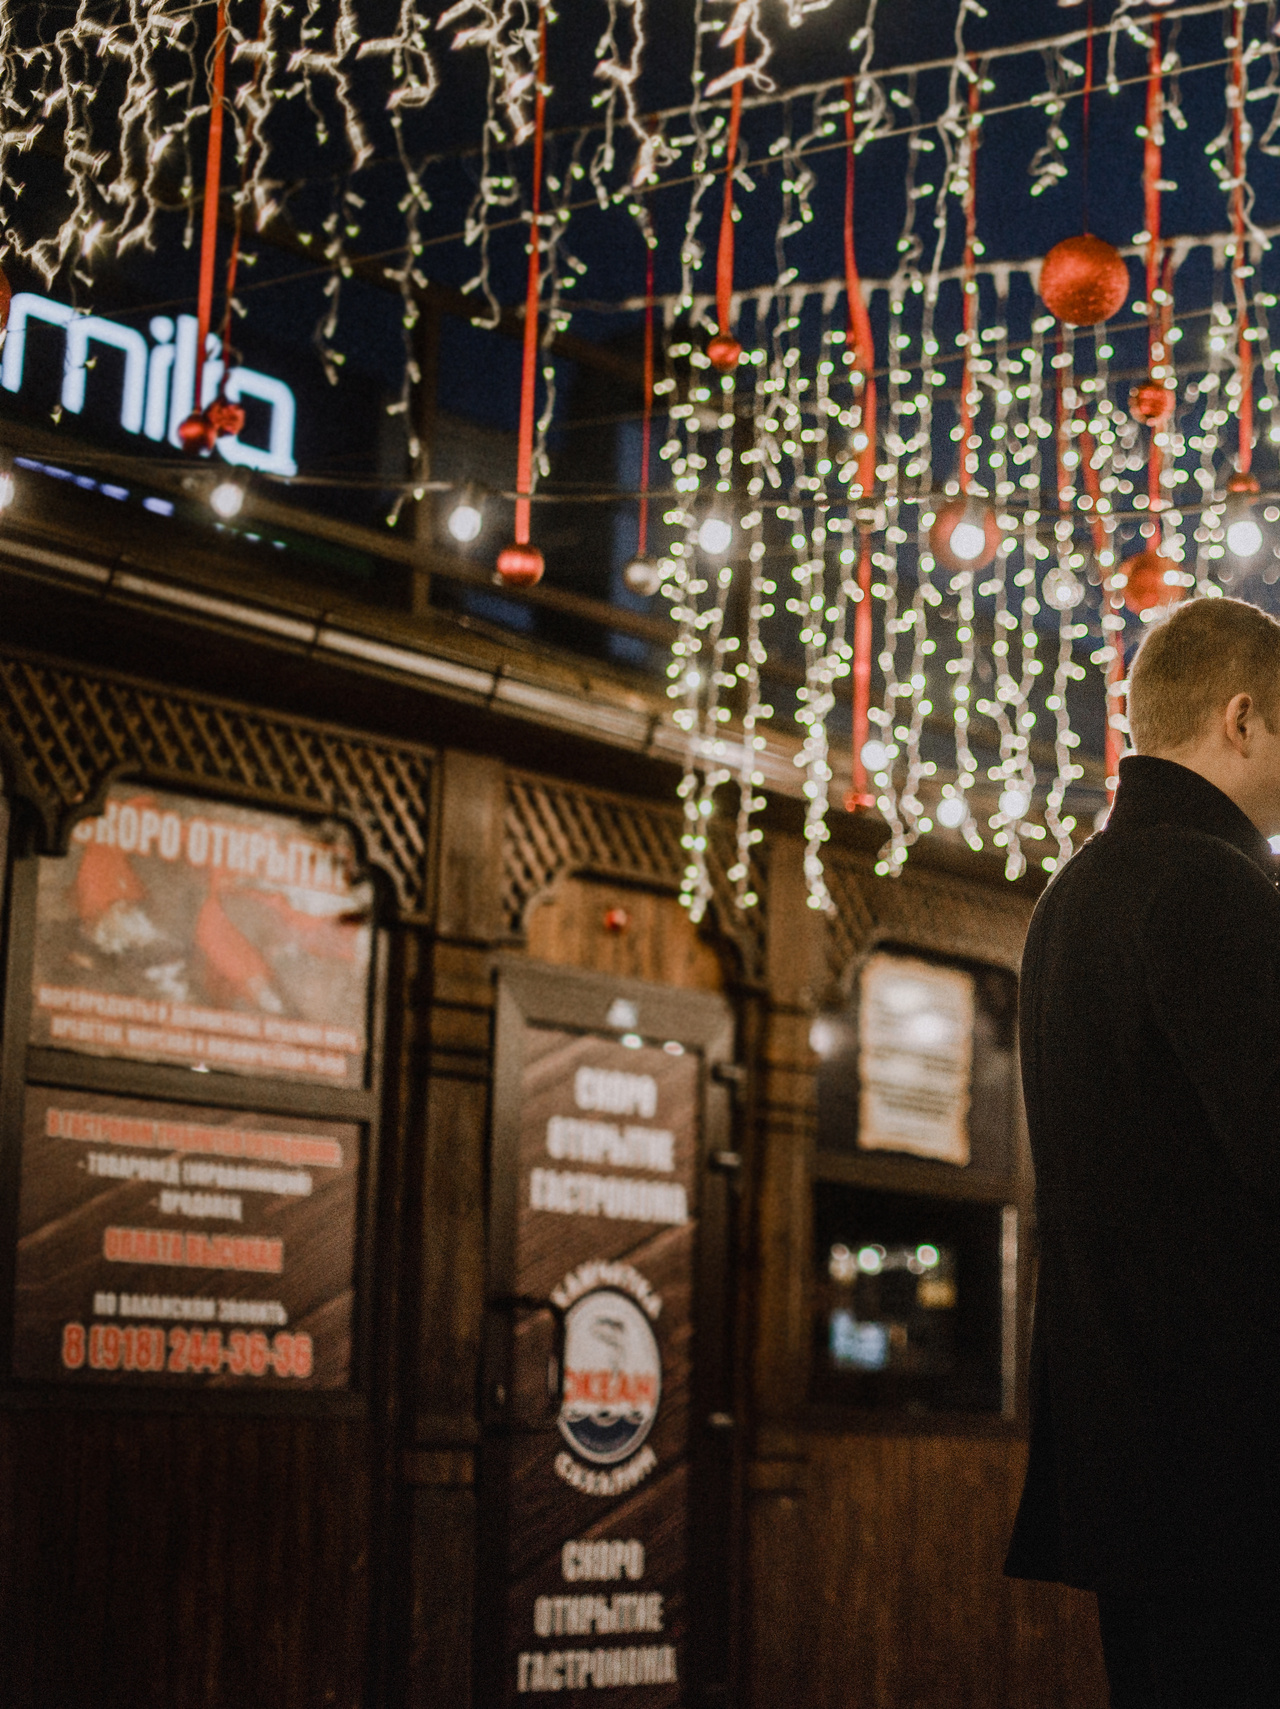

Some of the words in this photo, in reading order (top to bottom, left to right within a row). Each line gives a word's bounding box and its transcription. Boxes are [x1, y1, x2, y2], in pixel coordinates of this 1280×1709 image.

[574, 1065, 658, 1119] СКОРО
[62, 1321, 86, 1370] 8
[88, 1322, 166, 1373] (918)
[167, 1326, 314, 1379] 244-36-36
[561, 1538, 646, 1583] СКОРО
[533, 1591, 664, 1638] ОТКРЫТИЕ
